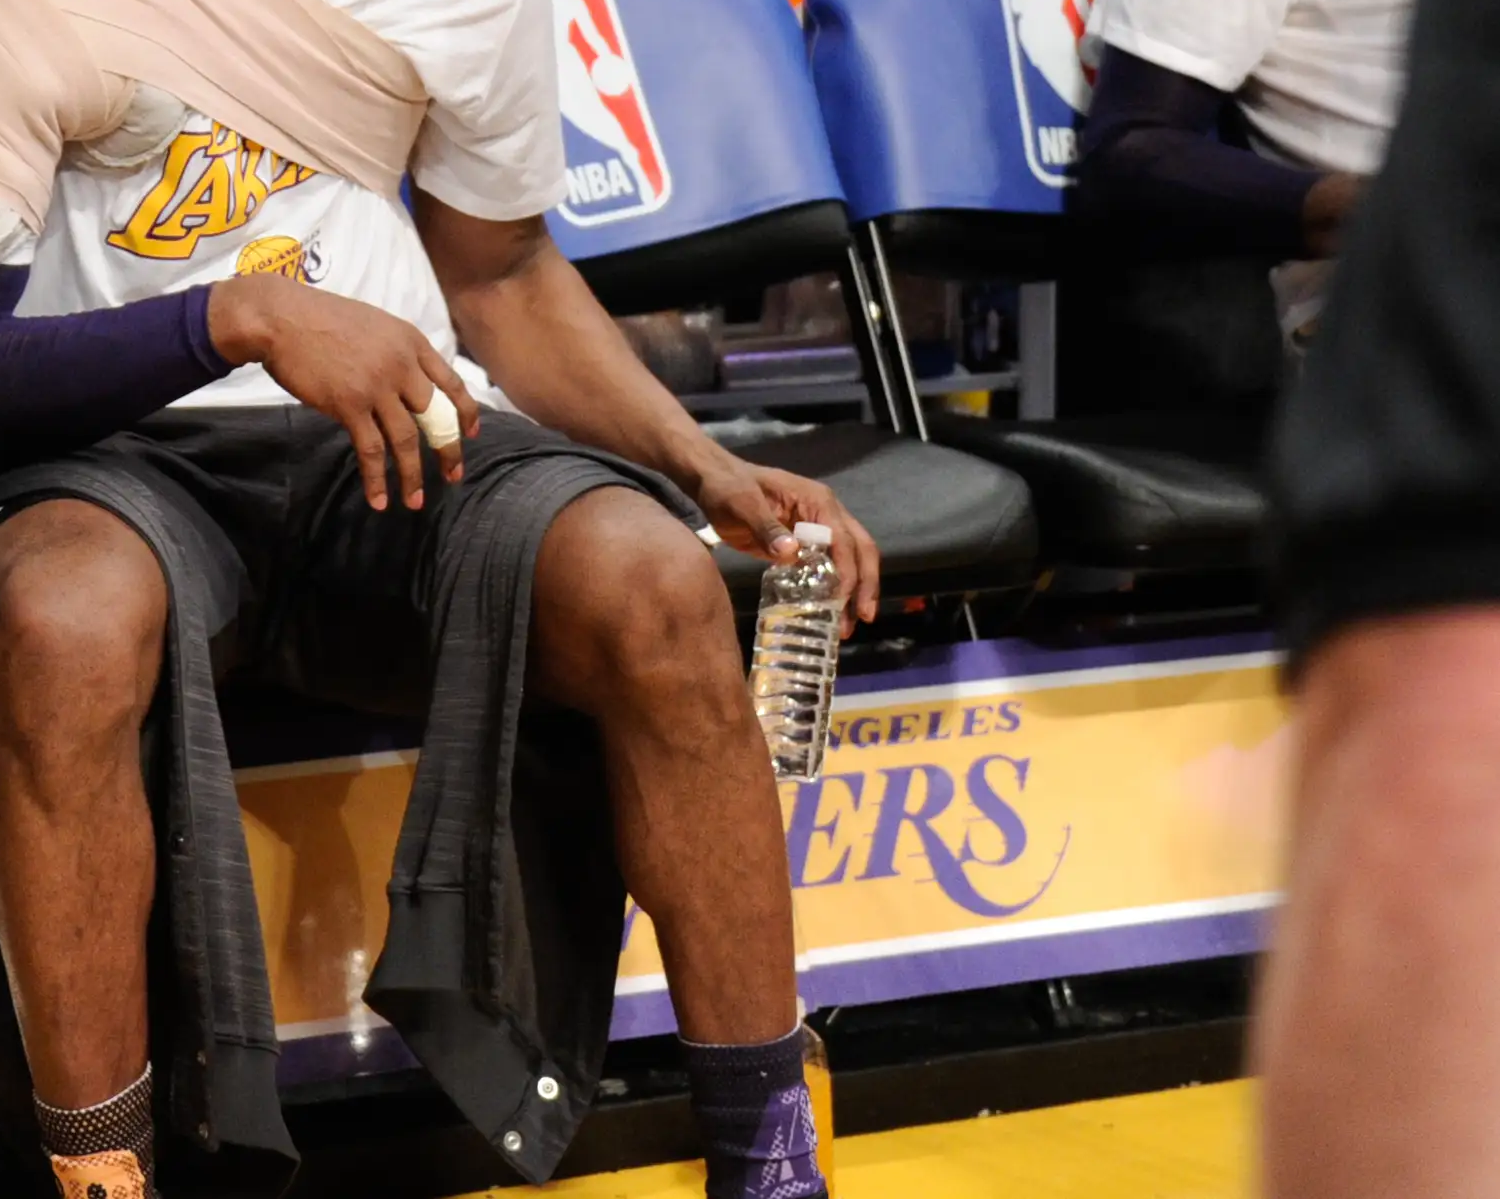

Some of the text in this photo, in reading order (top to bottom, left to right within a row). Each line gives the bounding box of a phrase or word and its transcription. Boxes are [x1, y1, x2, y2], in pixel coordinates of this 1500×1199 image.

[565, 158, 635, 205] NBA
[827, 701, 1023, 751] NGELES
[784, 754, 1071, 918] ERS
